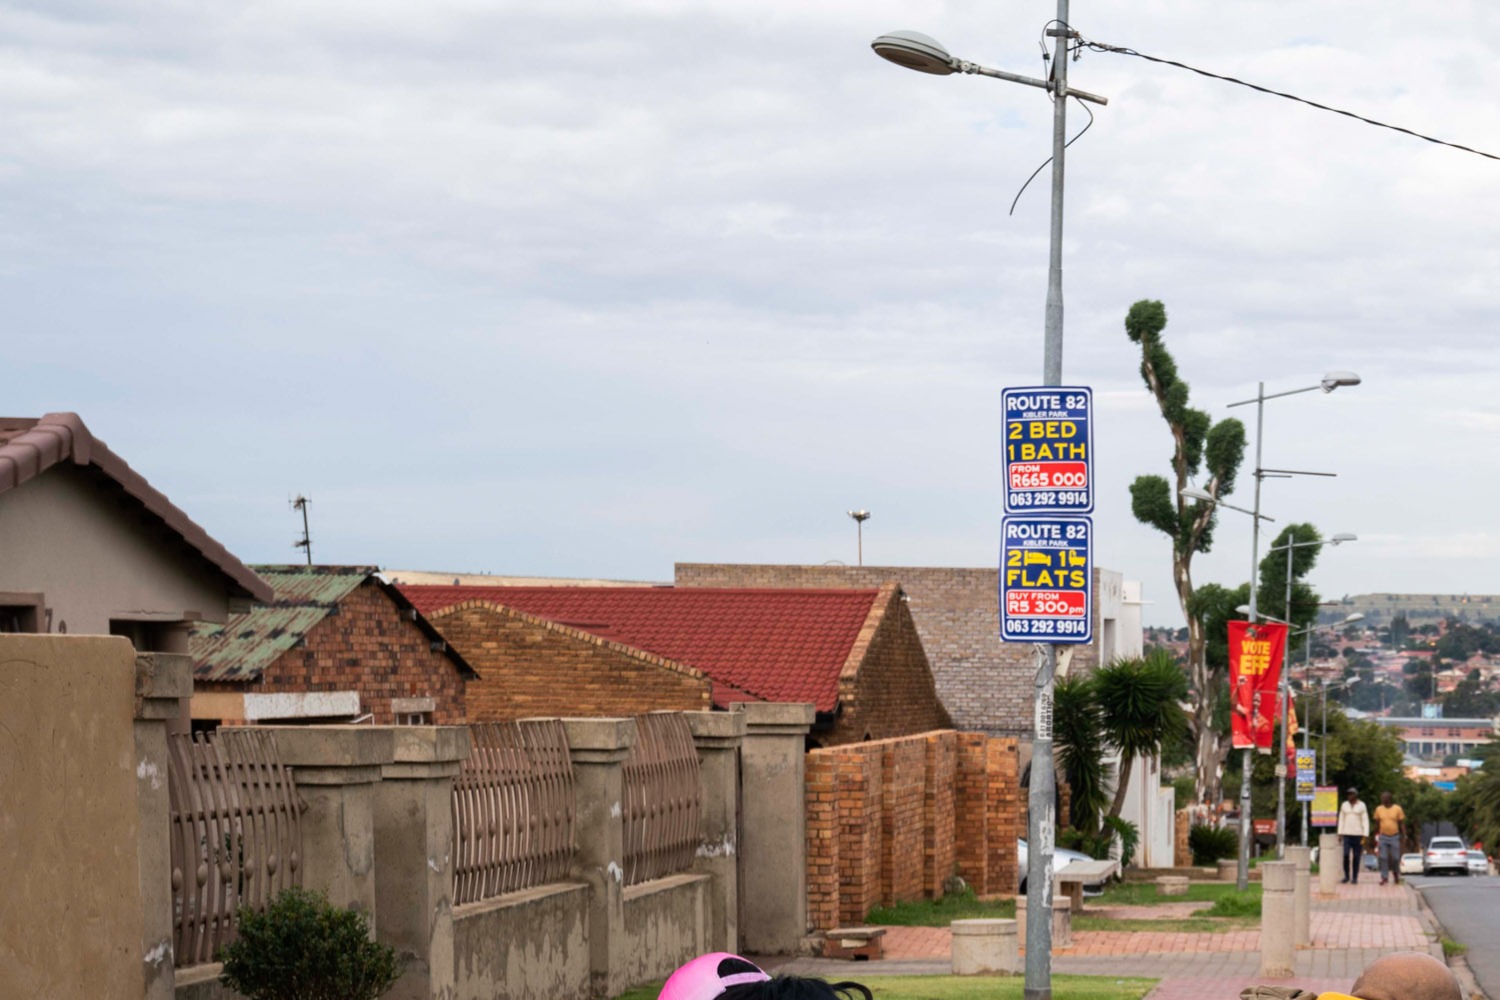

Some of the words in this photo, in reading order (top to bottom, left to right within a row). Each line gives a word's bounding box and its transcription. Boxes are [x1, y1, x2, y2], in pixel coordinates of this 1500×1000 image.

[1007, 395, 1061, 411] ROUTE
[1065, 395, 1086, 410] 82
[1048, 410, 1068, 418] PARK
[1009, 422, 1023, 440] 2
[1029, 421, 1077, 439] BED
[1008, 444, 1015, 461] 1
[1021, 443, 1086, 460] BATH
[1011, 465, 1040, 473] FROM
[1011, 473, 1050, 487] R665
[1052, 472, 1085, 486] 000
[1010, 492, 1033, 506] 063
[1034, 492, 1056, 505] 292
[1058, 491, 1087, 505] 9914
[1007, 524, 1062, 539] ROUTE
[1066, 525, 1086, 539] 82
[1007, 549, 1022, 567] 2
[1058, 550, 1066, 567] 1
[1007, 569, 1086, 588] FLATS
[1009, 592, 1029, 600] BUY
[1031, 592, 1060, 600] FROM
[1009, 601, 1030, 613] R5
[1034, 601, 1069, 613] 300
[1069, 606, 1084, 615] pm
[1006, 620, 1029, 633] 063
[1031, 620, 1054, 633] 292
[1056, 620, 1085, 634] 9914
[1241, 640, 1271, 655] VOTE
[1240, 654, 1271, 675] EFF
